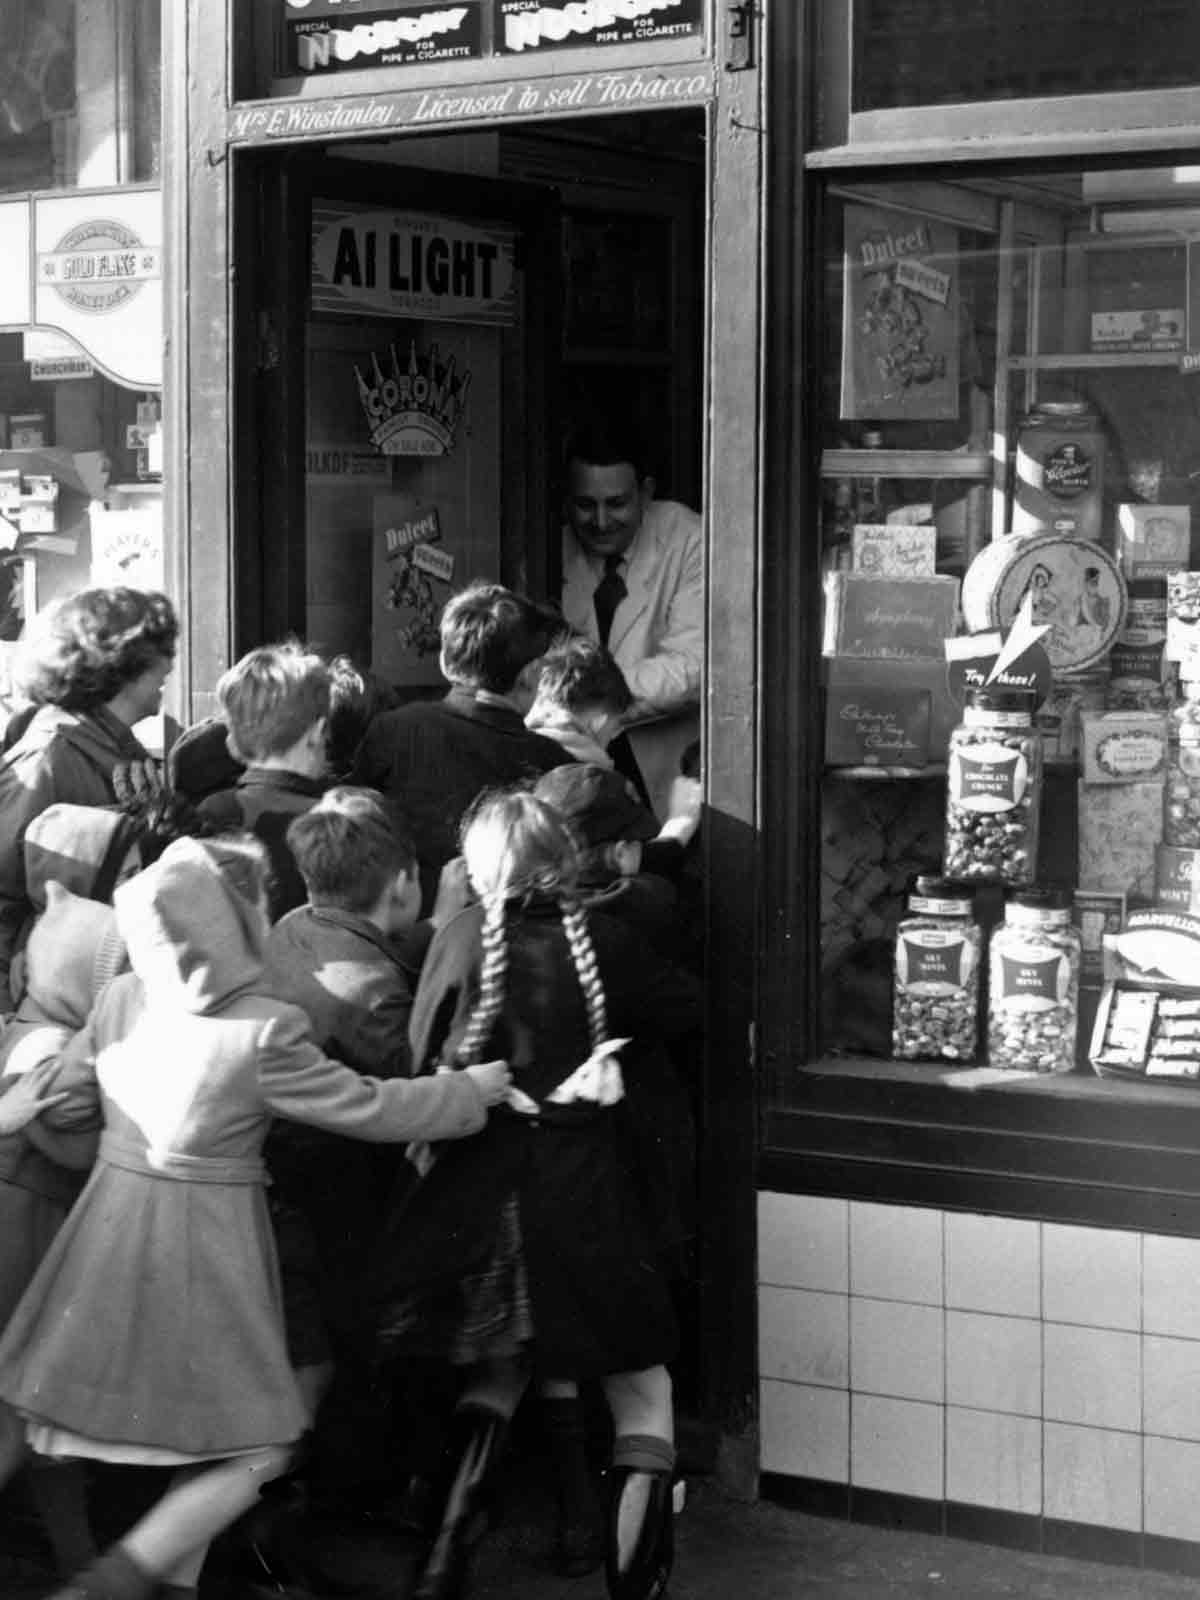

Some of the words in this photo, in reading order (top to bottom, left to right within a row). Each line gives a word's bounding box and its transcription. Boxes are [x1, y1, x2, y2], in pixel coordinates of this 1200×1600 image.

[501, 1, 541, 13] SPECIAL
[595, 31, 619, 42] PIPE
[635, 22, 692, 39] CIGARETTE
[633, 18, 654, 28] FOR
[416, 40, 435, 50] FOR
[381, 53, 403, 64] PIPE
[417, 46, 471, 61] CIGARETTE
[412, 86, 512, 121] Licensed
[518, 85, 540, 110] to
[544, 78, 593, 107] sell
[389, 229, 499, 299] LIGHT
[964, 668, 986, 687] Try
